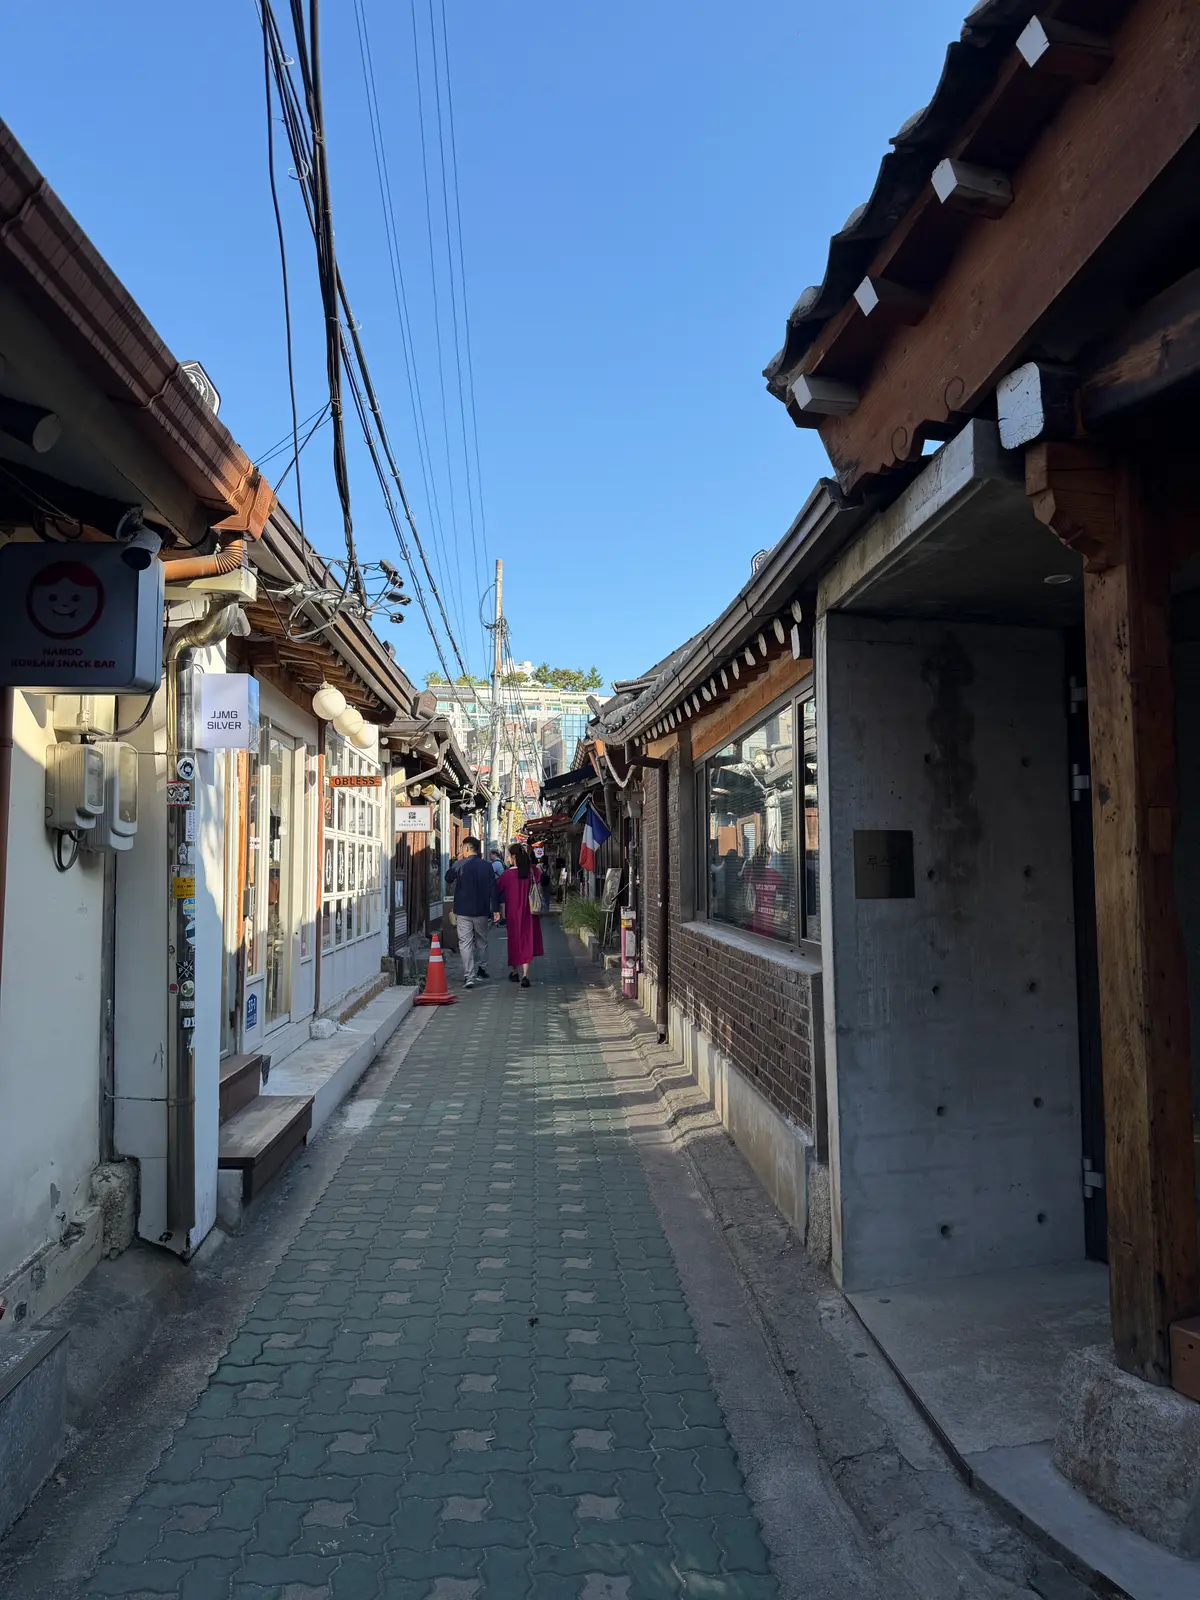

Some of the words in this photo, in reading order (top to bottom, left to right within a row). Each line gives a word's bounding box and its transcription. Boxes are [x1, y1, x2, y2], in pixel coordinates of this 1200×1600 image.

[42, 648, 84, 657] NAMDO
[11, 659, 55, 668] KOREAN
[56, 659, 92, 668] SNACK
[94, 660, 116, 669] BAR
[210, 710, 238, 719] JJMG
[206, 721, 242, 730] SILVER
[334, 776, 376, 786] OBLESS
